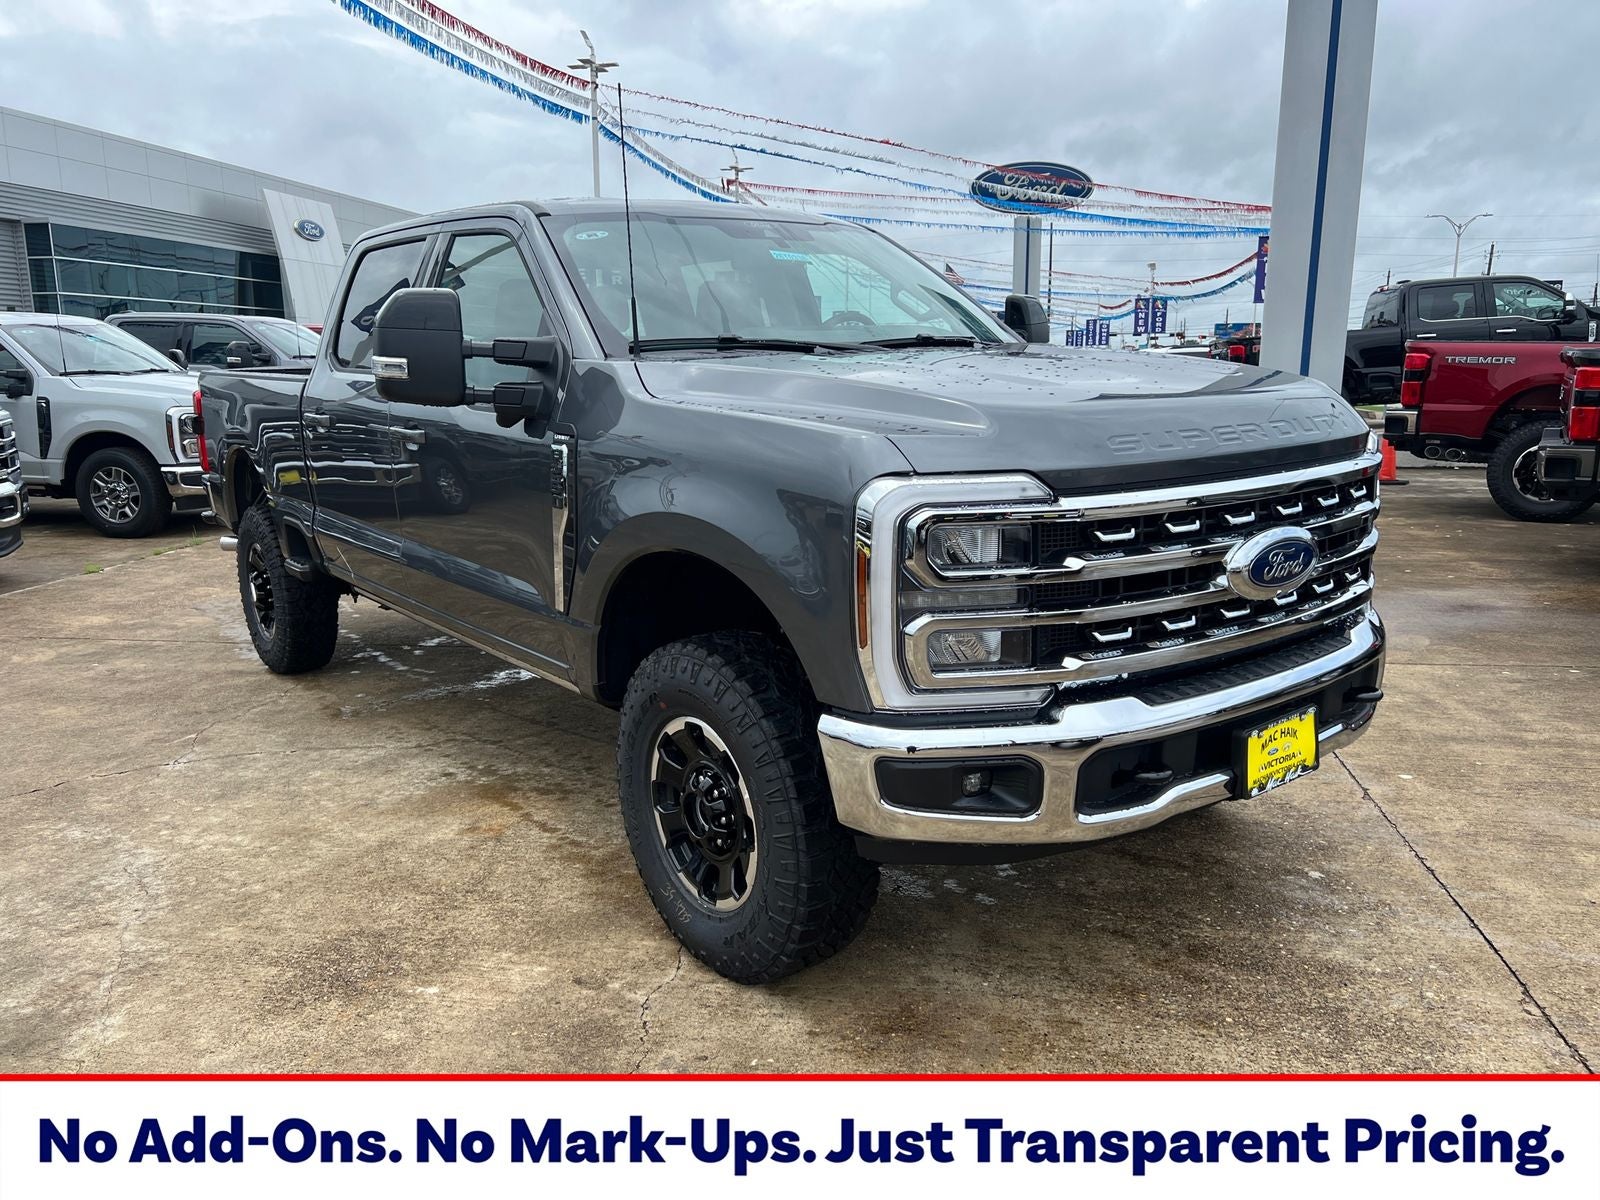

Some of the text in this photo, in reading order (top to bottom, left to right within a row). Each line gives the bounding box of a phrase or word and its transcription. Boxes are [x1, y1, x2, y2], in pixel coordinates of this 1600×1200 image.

[995, 172, 1068, 201] Ford
[304, 222, 321, 237] Ford
[1136, 312, 1146, 333] NEW
[1155, 312, 1163, 333] FORD
[1445, 356, 1517, 365] TREMOR
[1106, 412, 1351, 455] SUPER DUTY
[1263, 547, 1305, 581] Ford
[1260, 726, 1299, 754] MAC HAIK
